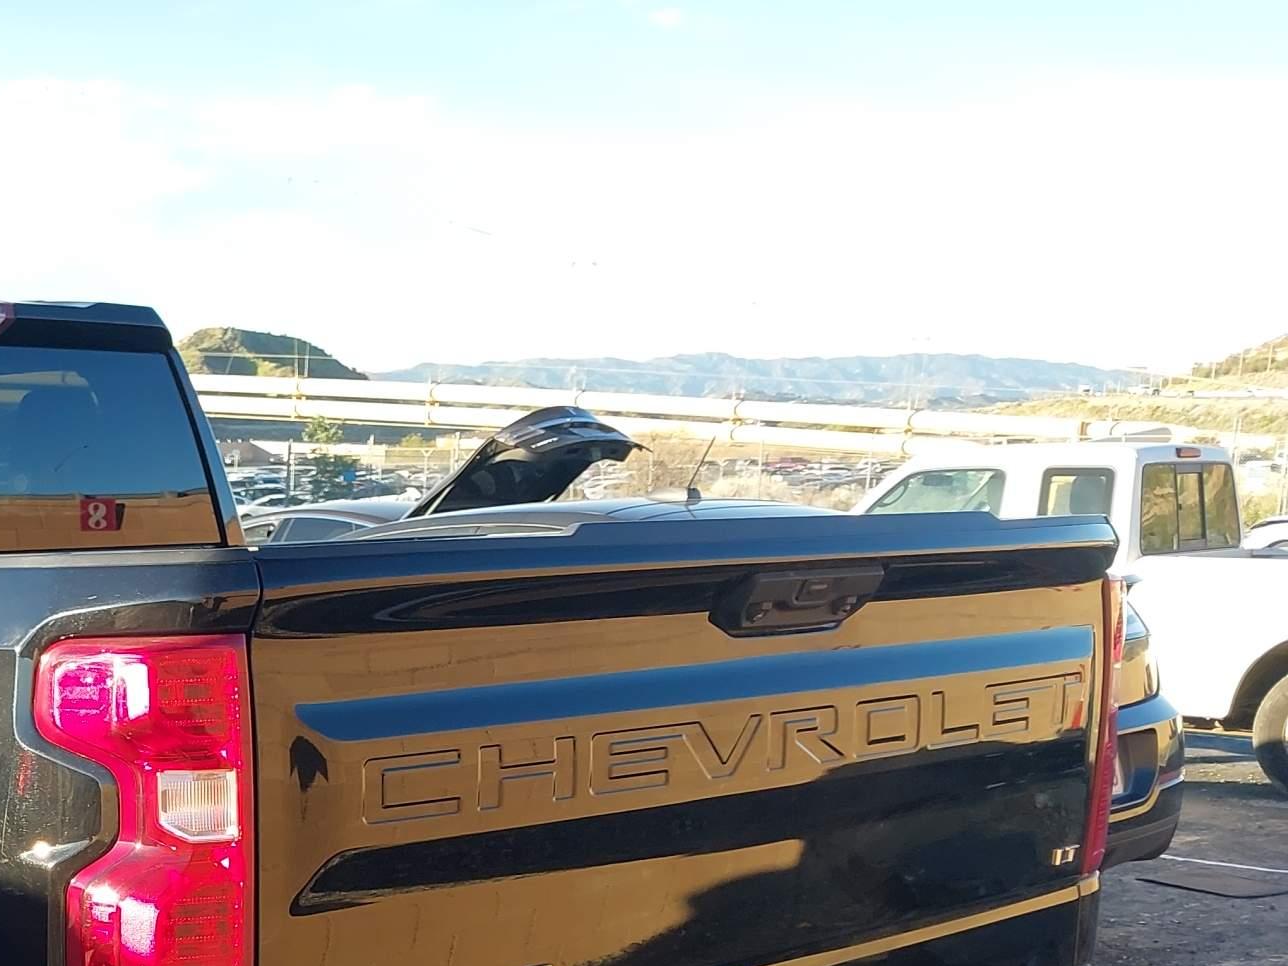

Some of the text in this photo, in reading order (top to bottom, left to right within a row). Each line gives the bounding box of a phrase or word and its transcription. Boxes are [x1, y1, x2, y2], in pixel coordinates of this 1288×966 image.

[88, 502, 108, 530] 8
[362, 671, 1083, 825] CHEVROLET
[1052, 844, 1081, 866] LT
